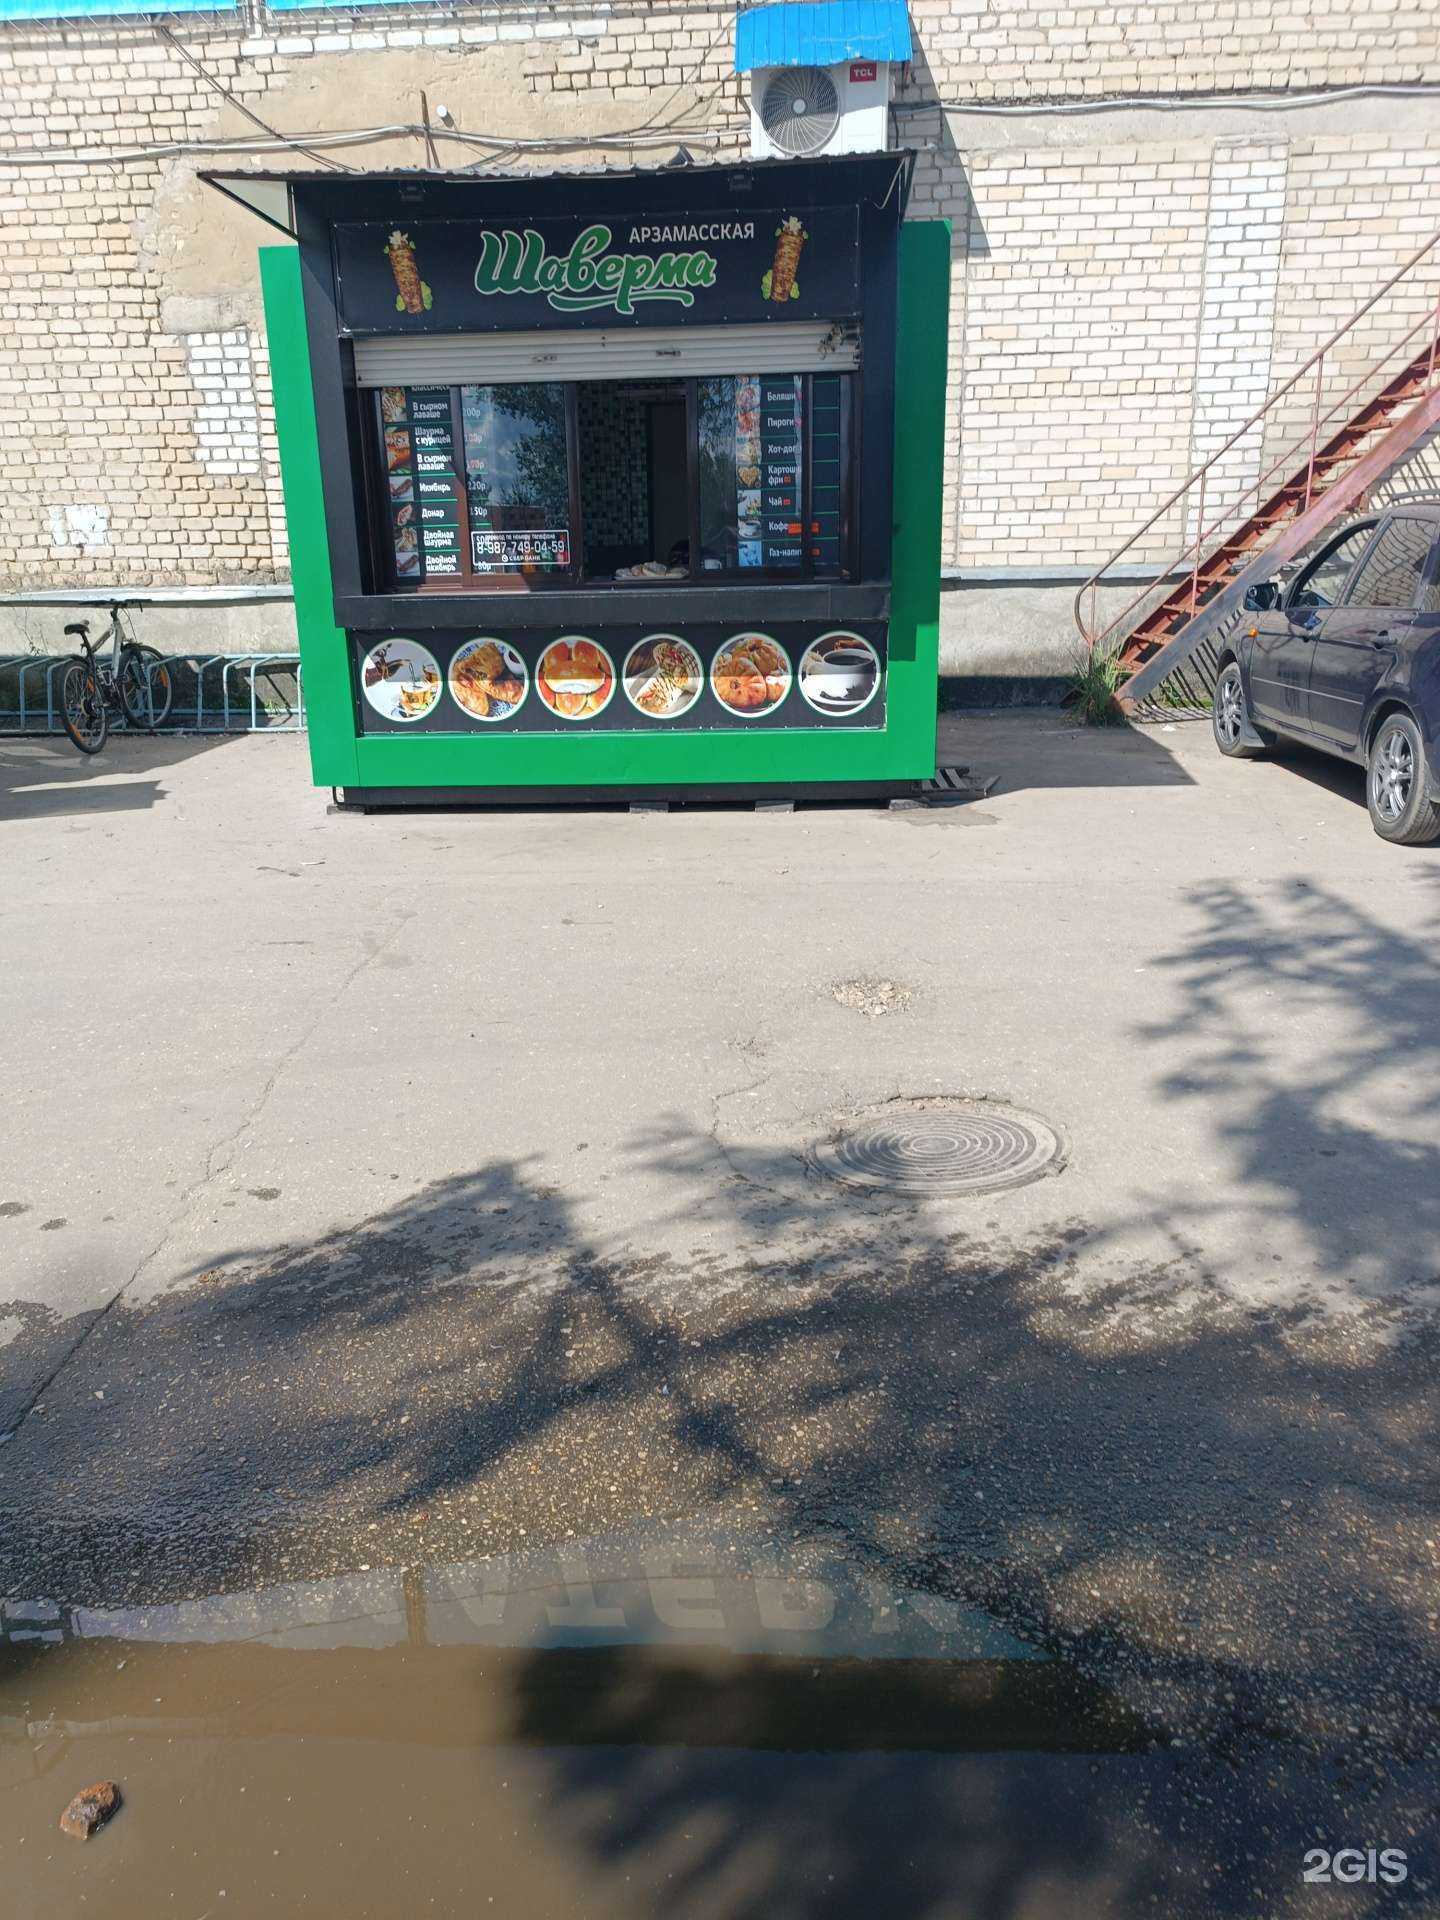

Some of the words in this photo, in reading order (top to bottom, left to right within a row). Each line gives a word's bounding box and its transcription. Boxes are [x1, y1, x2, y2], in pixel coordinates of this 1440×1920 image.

[854, 68, 873, 77] TCL
[629, 222, 755, 243] АРЗАМАССКАЯ
[474, 224, 718, 315] Шаверма
[767, 417, 794, 429] Пироги
[768, 496, 783, 506] Чай
[477, 540, 565, 554] 8-987-749-04-59
